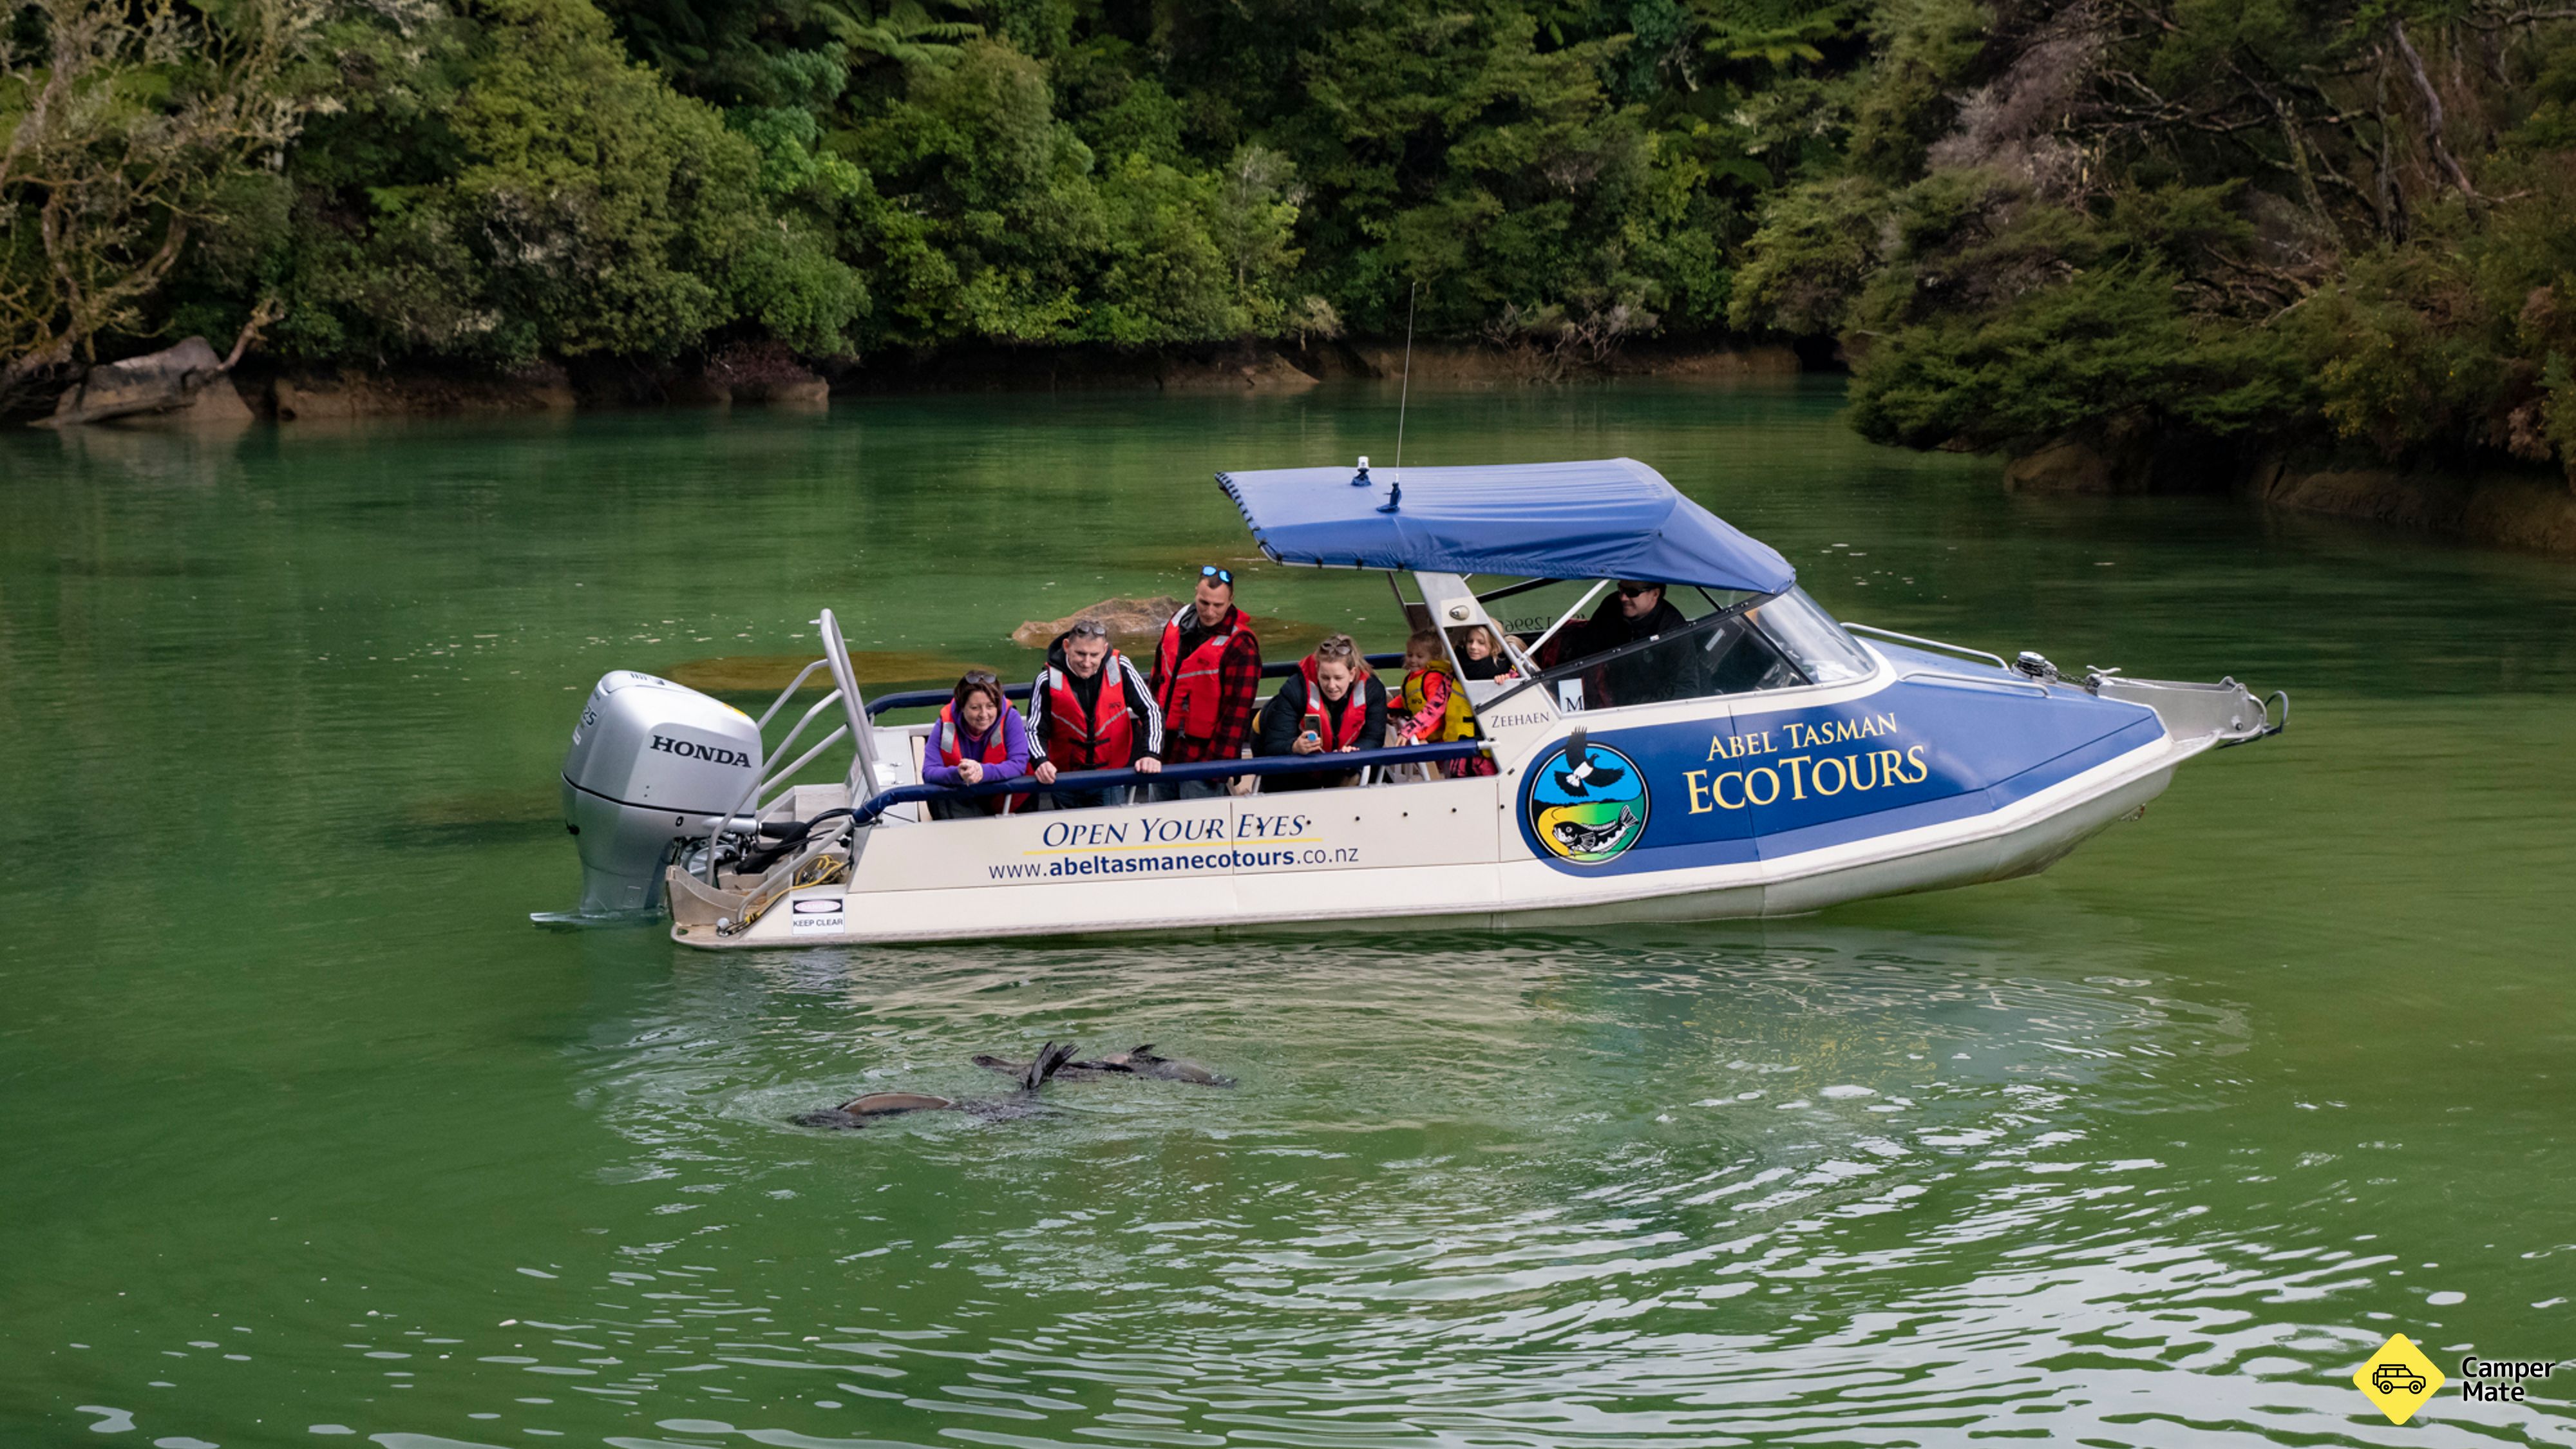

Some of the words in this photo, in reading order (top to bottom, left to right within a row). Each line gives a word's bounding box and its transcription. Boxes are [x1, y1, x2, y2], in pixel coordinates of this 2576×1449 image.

[1491, 712, 1550, 728] ZEEHAEN
[1706, 730, 1777, 762] ABEL
[1783, 712, 1898, 750] TASMAN
[650, 734, 752, 768] HONDA
[1042, 822, 1129, 848] OPEN
[1140, 817, 1226, 842] YOUR
[1236, 813, 1306, 838] EYES
[989, 846, 1359, 880] www.abeltasmanecotours.co.nz
[816, 918, 843, 927] CLEAR
